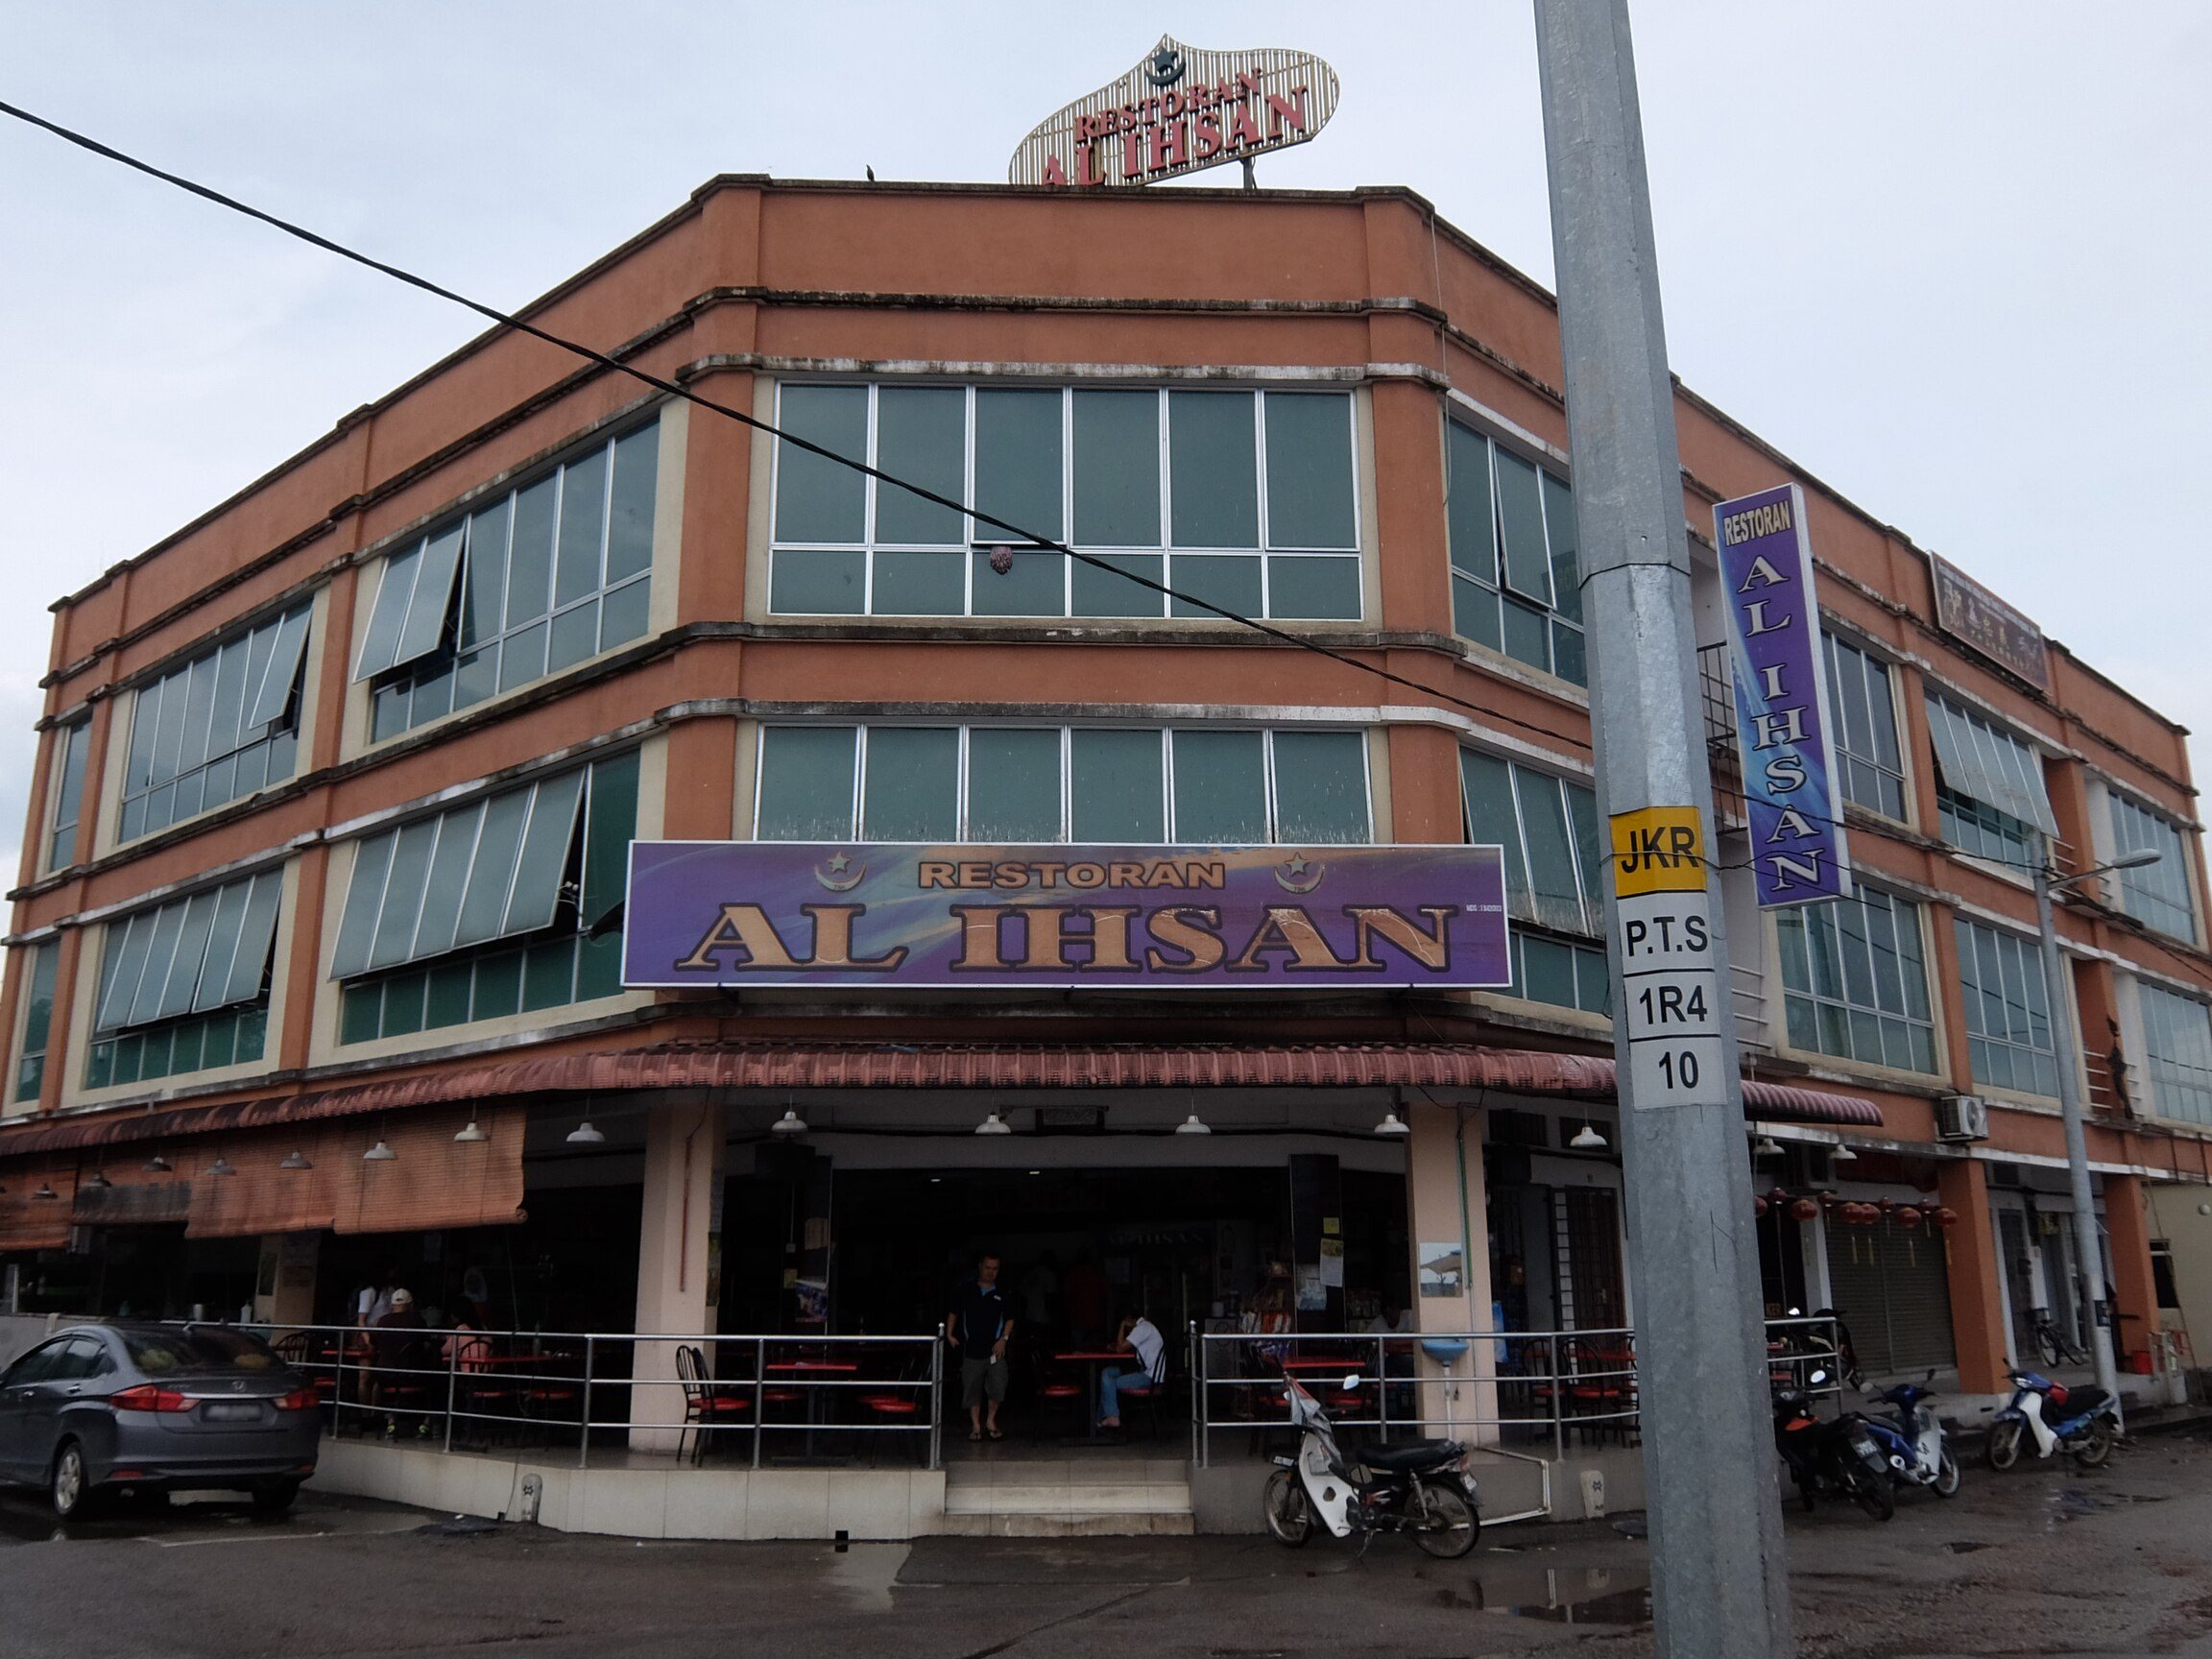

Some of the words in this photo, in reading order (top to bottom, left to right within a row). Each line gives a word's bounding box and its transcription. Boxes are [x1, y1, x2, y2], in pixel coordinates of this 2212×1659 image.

[1074, 67, 1261, 142] RESTORAN
[1044, 144, 1104, 185] AL
[1122, 84, 1308, 180] IHSAN
[1723, 499, 1791, 546] RESTORAN
[1622, 826, 1699, 874] JKR
[918, 861, 1225, 889] RESTORAN
[674, 902, 909, 973] AL
[950, 903, 1459, 974] IHSAN
[1626, 915, 1708, 956] P.T.S
[1640, 985, 1707, 1024] 1R4
[1659, 1051, 1698, 1089] 10
